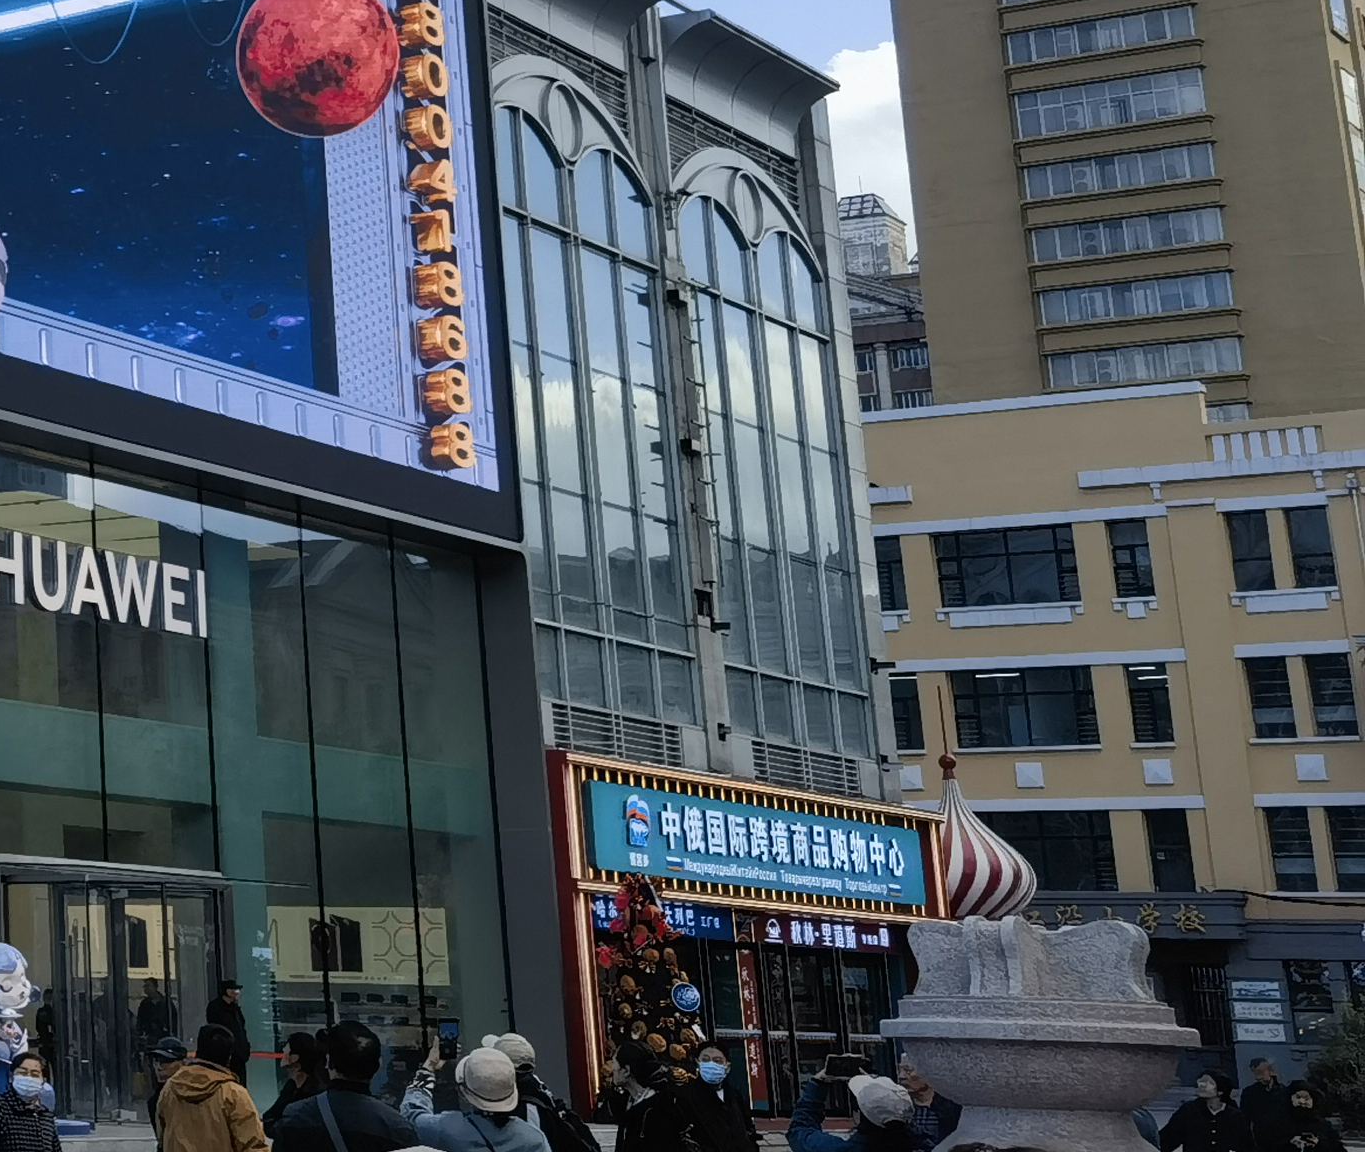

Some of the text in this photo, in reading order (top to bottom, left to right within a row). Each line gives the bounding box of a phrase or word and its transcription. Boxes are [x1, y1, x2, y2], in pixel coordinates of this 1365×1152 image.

[660, 802, 905, 878] 中俄国际跨境商品购物中心
